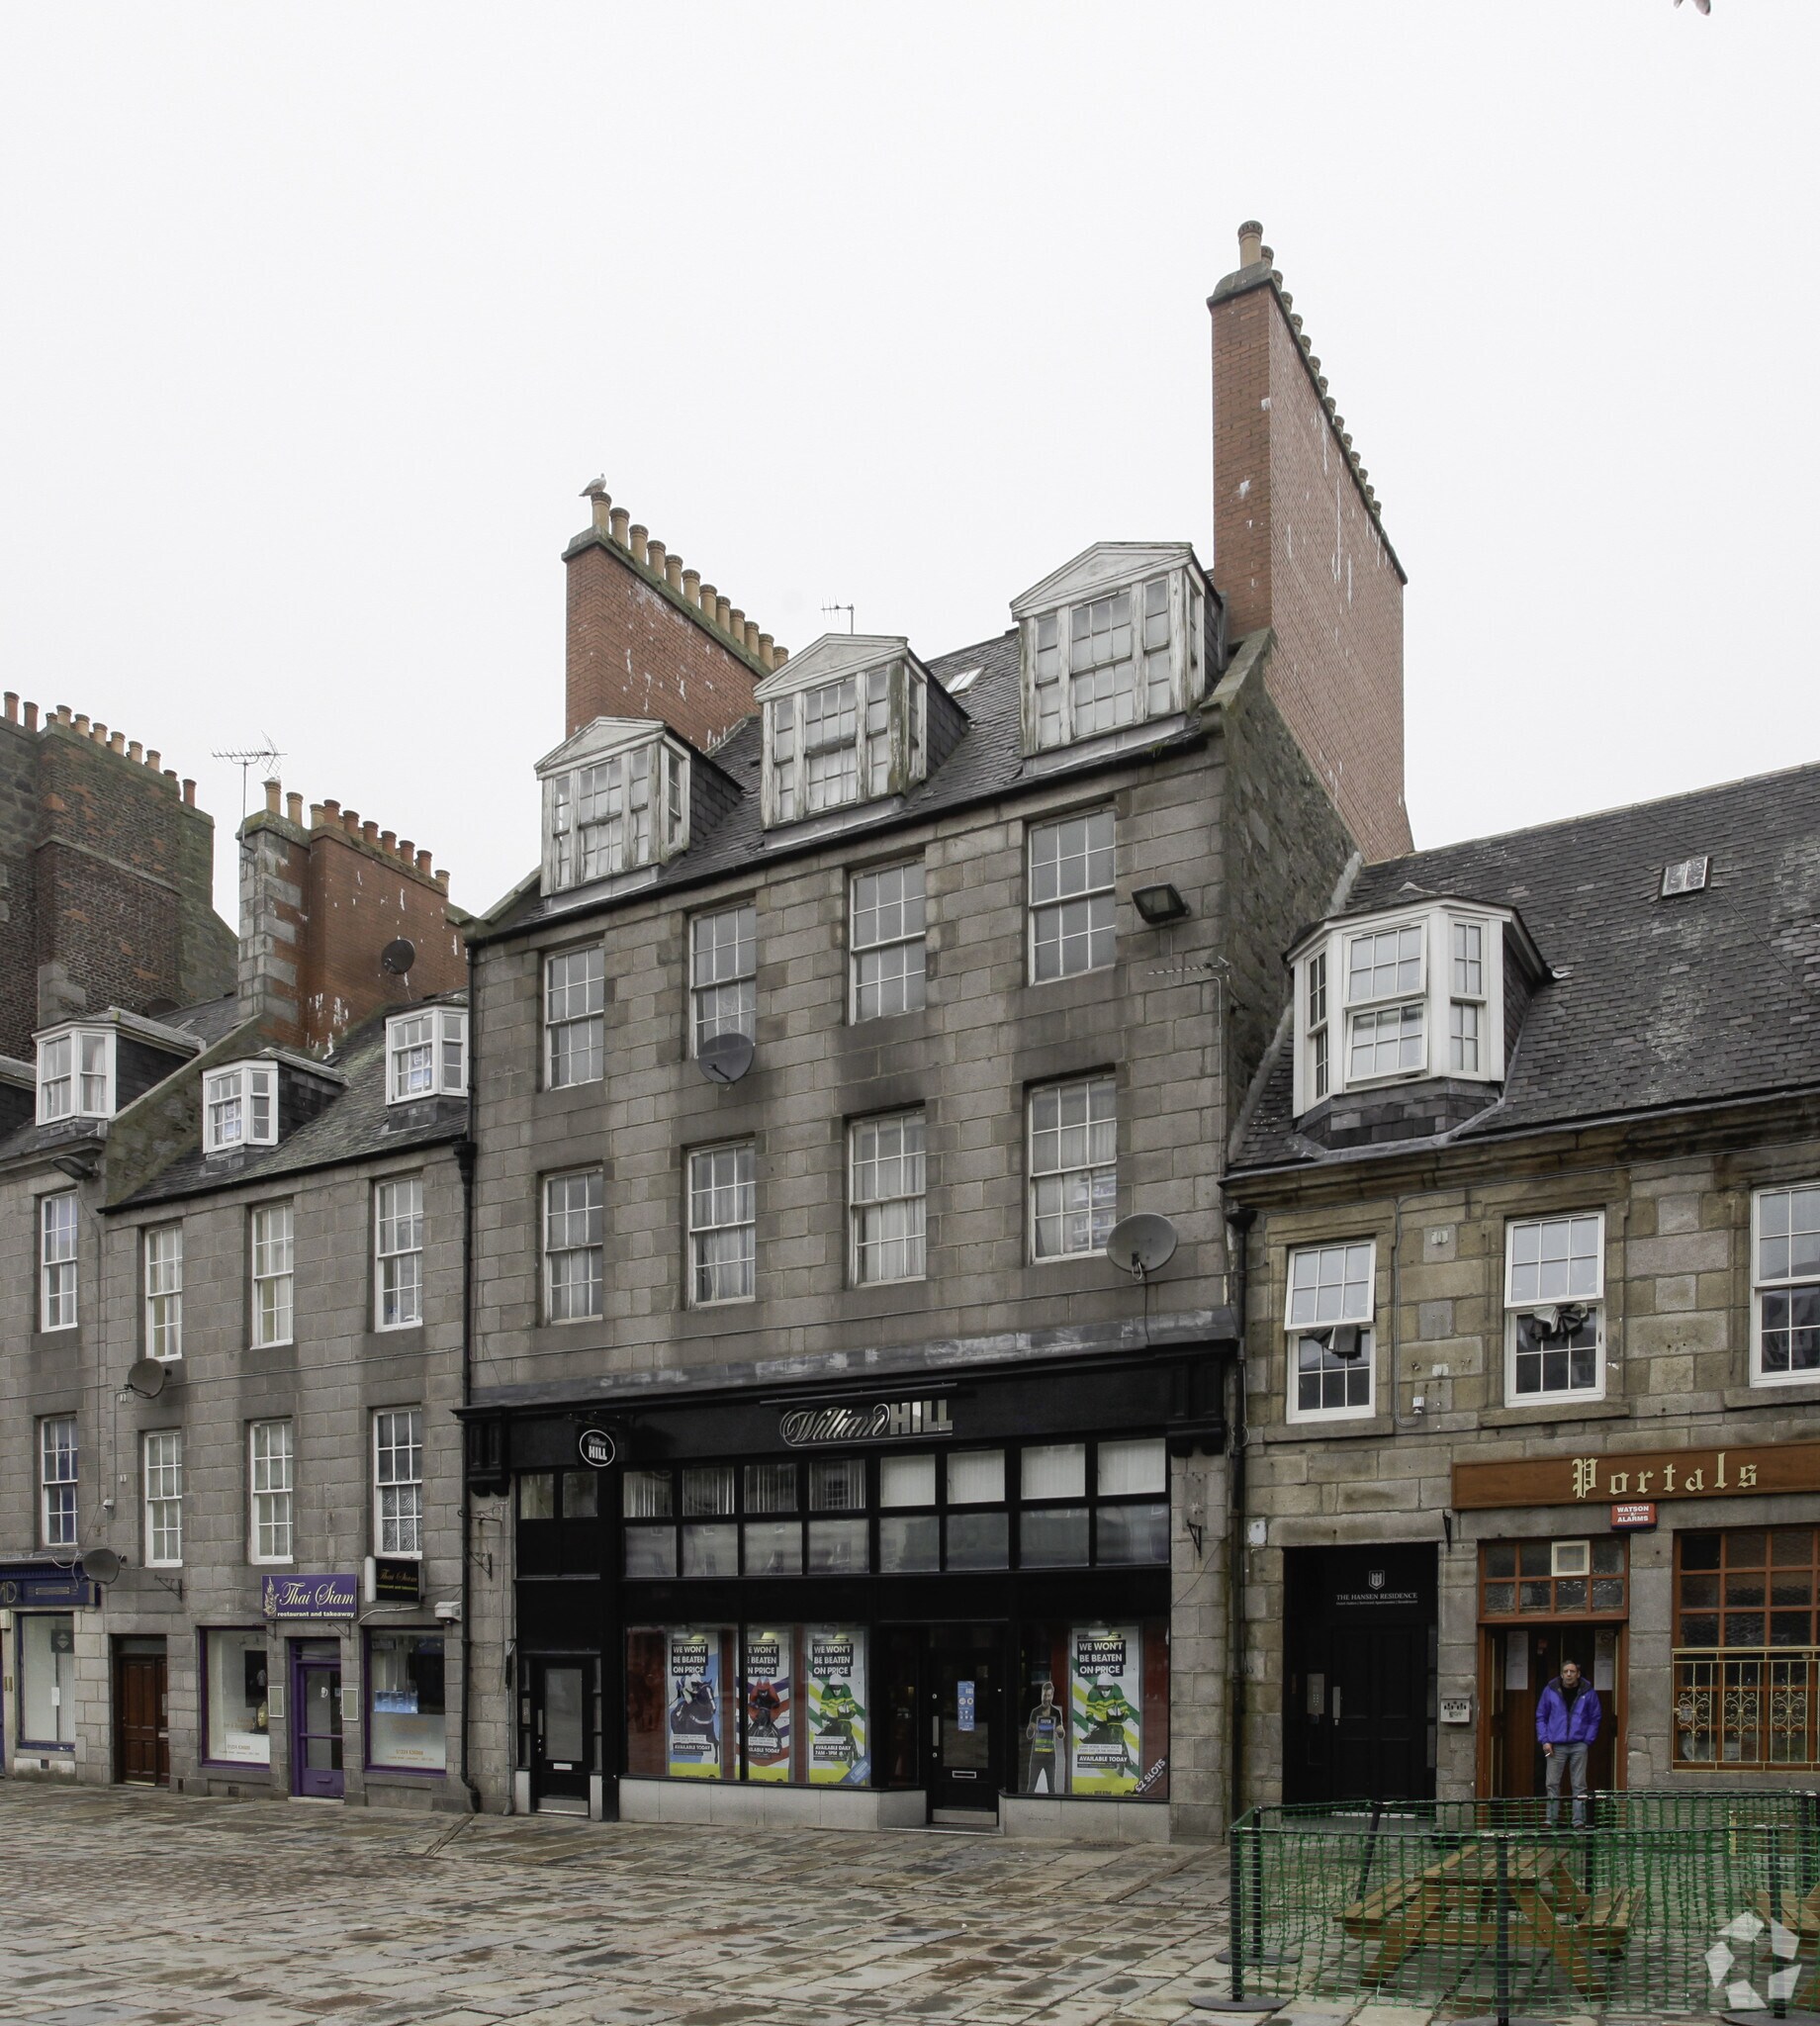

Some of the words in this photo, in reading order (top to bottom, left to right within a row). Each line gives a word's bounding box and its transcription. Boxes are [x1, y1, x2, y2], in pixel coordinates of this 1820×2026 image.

[779, 1404, 889, 1446] William
[890, 1399, 953, 1435] HILL
[589, 1445, 607, 1460] HILL
[1572, 1452, 1758, 1499] Portals
[279, 1581, 312, 1606] Thai
[315, 1581, 354, 1609] Siam
[673, 1645, 683, 1654] WE
[684, 1645, 706, 1654] WON'T
[753, 1645, 777, 1654] WON'T
[813, 1645, 825, 1654] WE
[825, 1645, 851, 1654] WON'T
[1078, 1642, 1092, 1651] WE
[1093, 1642, 1123, 1651] WON'T
[1079, 1654, 1090, 1663] BE
[755, 1666, 775, 1675] PRICE
[1079, 1665, 1094, 1674] ON
[1095, 1665, 1121, 1674] PRICE
[1136, 1781, 1146, 1793] £2
[1144, 1759, 1166, 1782] SLOTS
